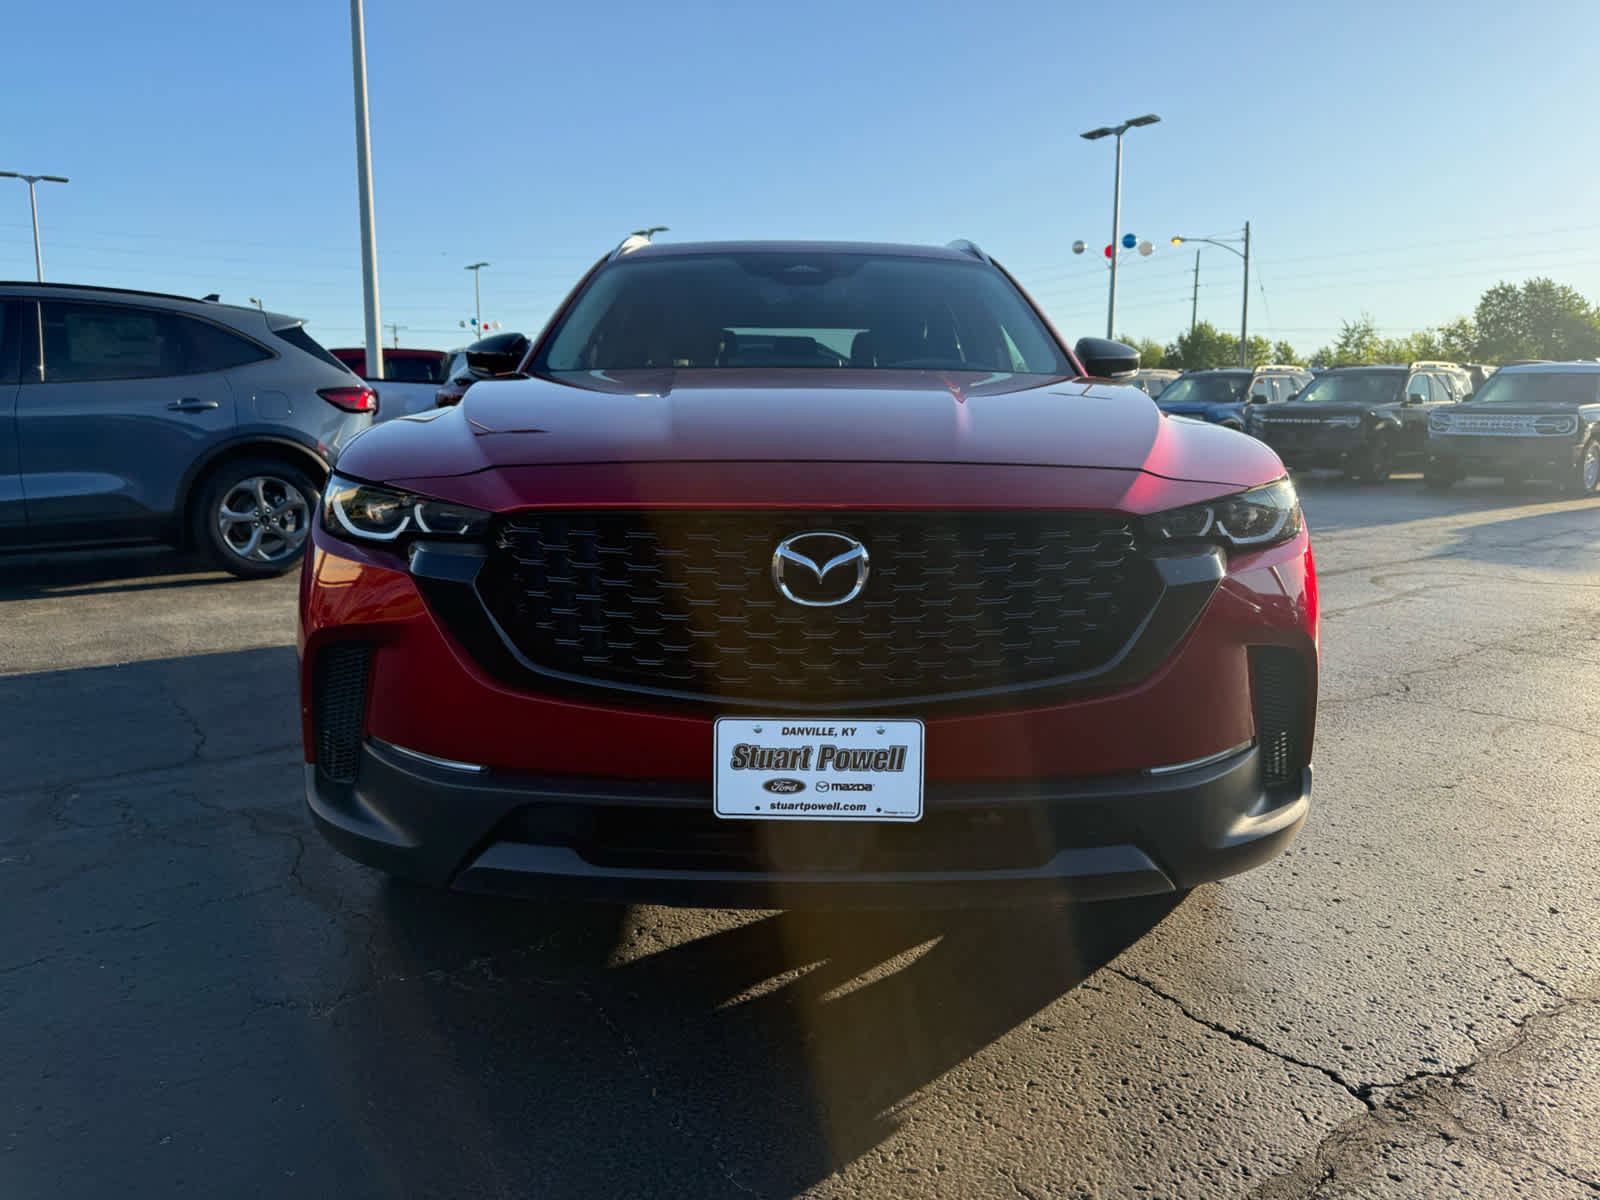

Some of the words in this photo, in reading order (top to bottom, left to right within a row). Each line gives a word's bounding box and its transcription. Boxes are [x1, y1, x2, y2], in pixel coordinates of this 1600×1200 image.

[781, 727, 838, 737] DANVILLE,
[841, 727, 857, 736] KY
[730, 743, 814, 771] Stuart
[816, 744, 908, 772] Powell
[771, 780, 798, 792] Ford
[770, 801, 867, 812] stuartpowell.com
